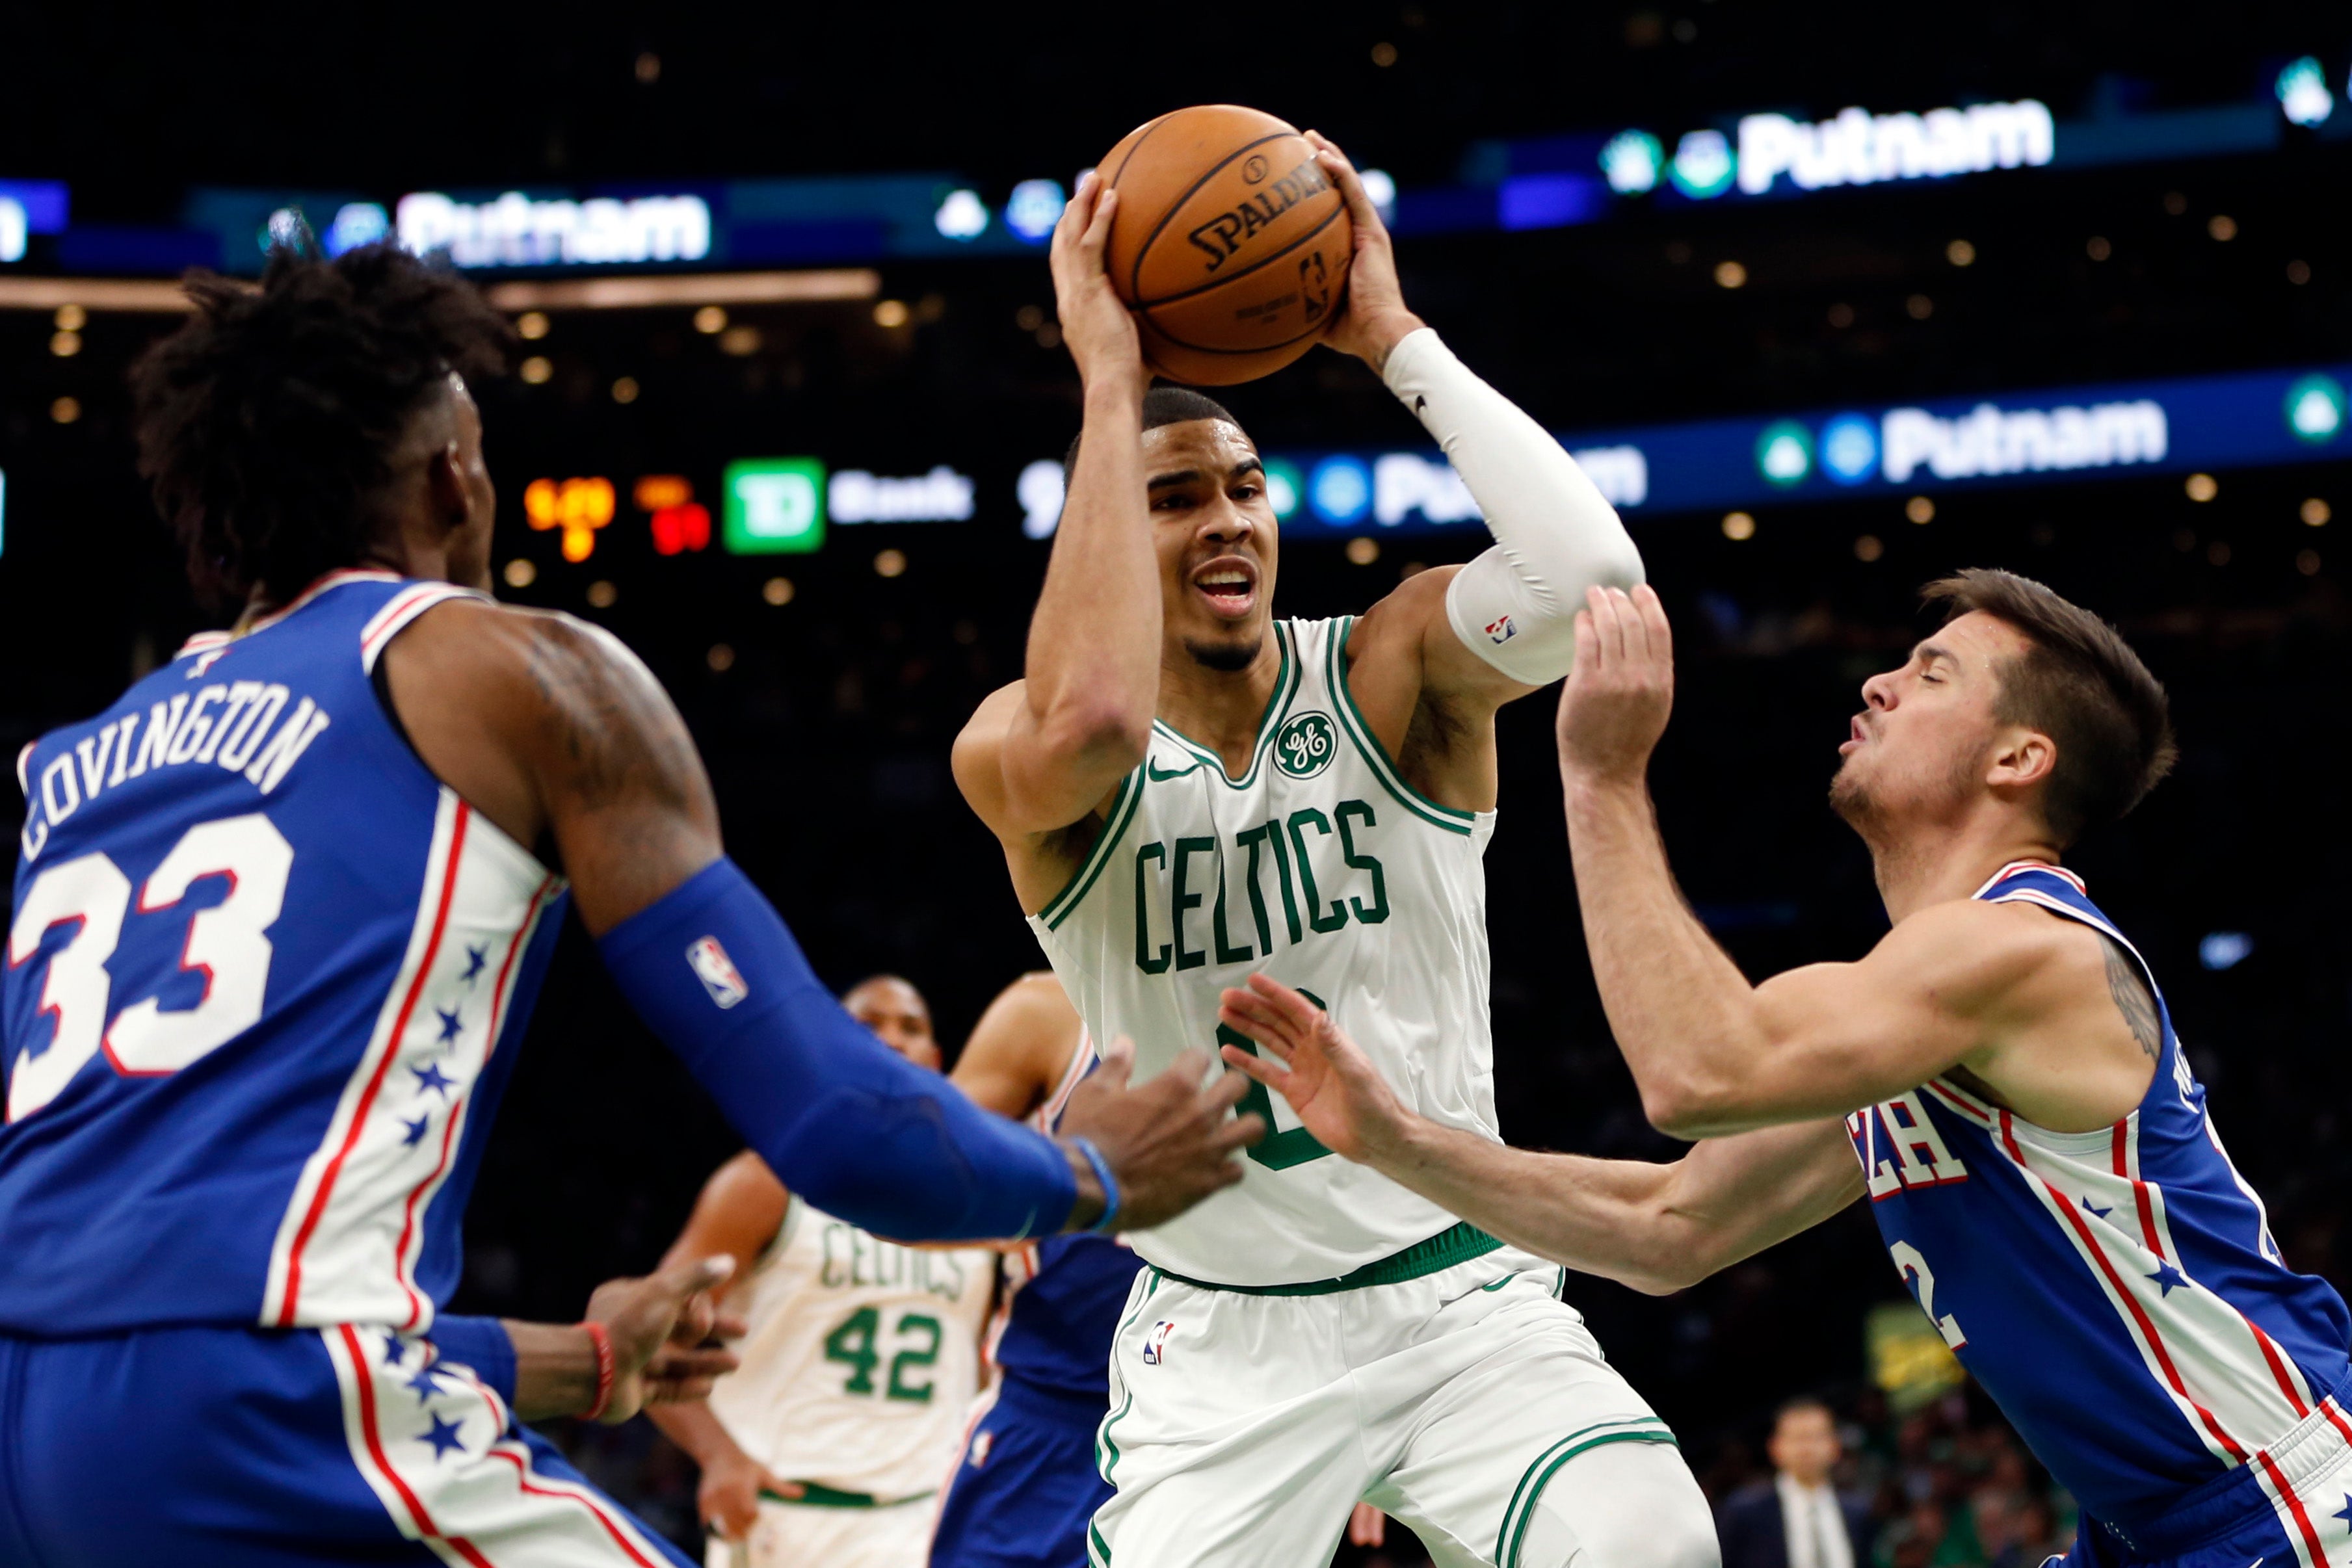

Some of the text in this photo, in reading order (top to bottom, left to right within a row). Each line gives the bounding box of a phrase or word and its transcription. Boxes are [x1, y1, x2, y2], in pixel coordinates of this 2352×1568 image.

[1738, 98, 2054, 194] Putnam
[397, 192, 711, 268] Putnam
[1187, 155, 1328, 273] SPALDIN
[1882, 400, 2167, 483] Putnam
[735, 473, 817, 538] TD
[21, 681, 330, 863] COVINGTON
[1135, 800, 1390, 975] CELTICS
[6, 813, 295, 1125] 33
[824, 1305, 944, 1403] 42
